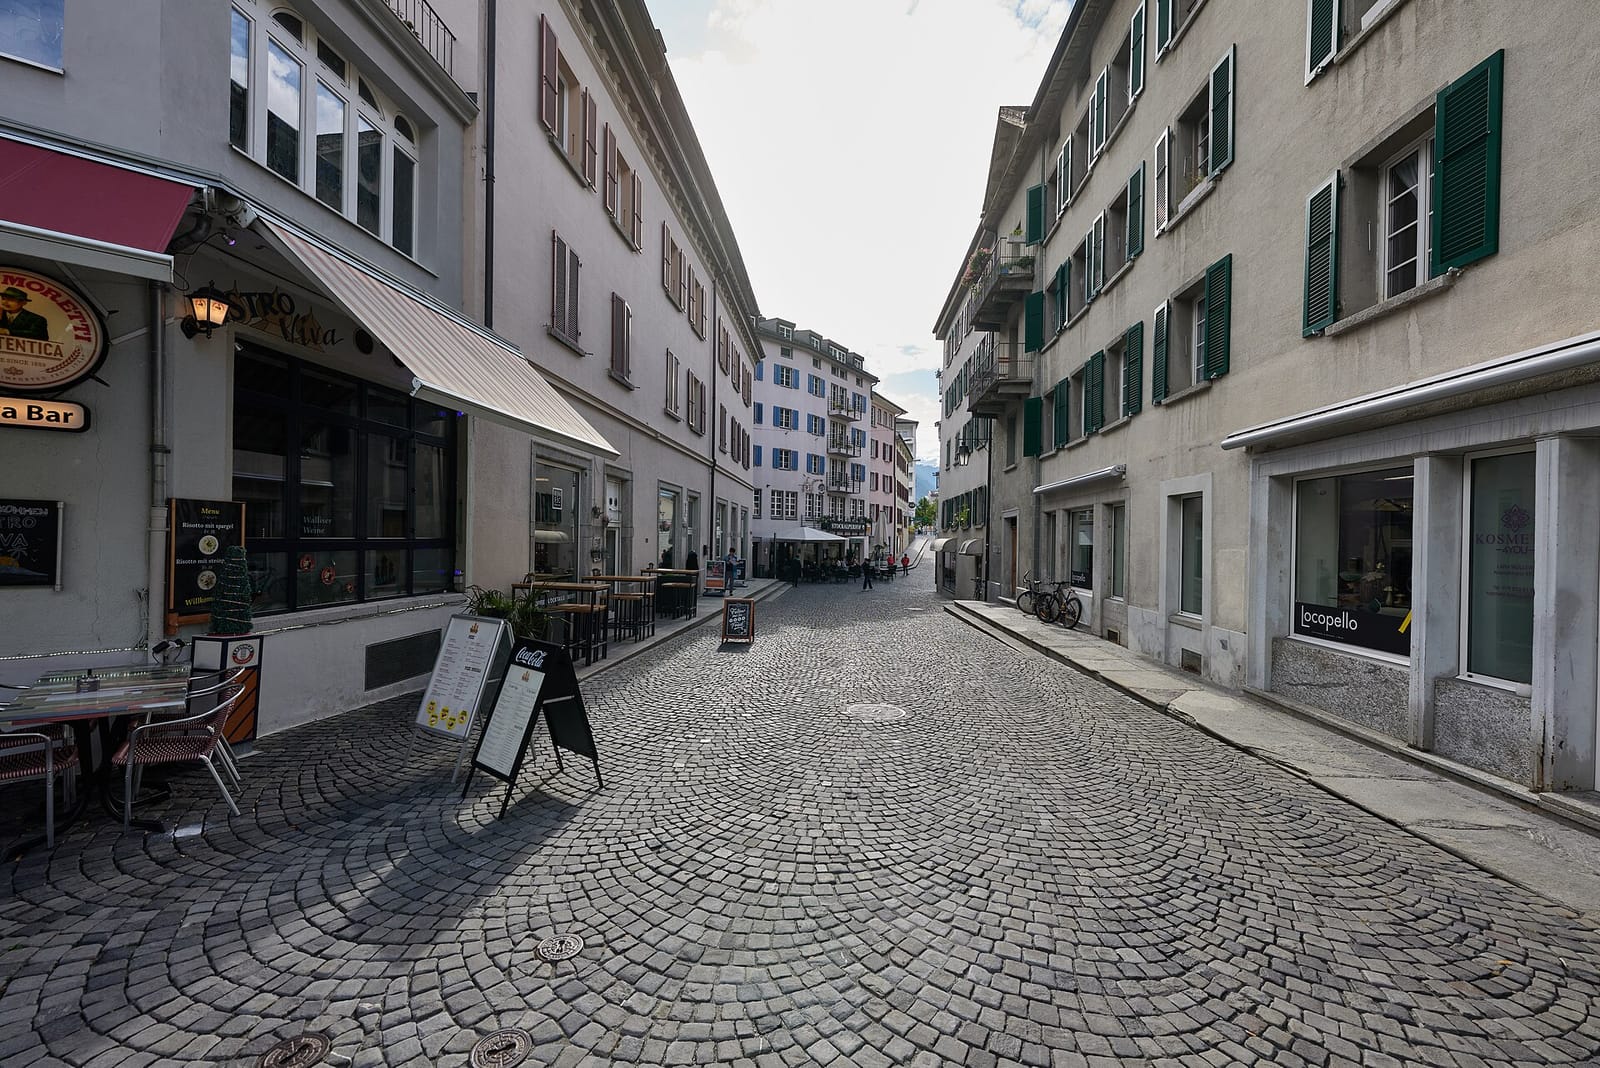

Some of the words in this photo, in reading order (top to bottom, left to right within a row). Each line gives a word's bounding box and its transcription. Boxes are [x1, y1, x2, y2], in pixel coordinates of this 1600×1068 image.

[1, 274, 92, 343] MORETTI
[278, 312, 345, 347] Viva
[27, 404, 73, 423] Bar
[200, 507, 221, 515] Menu
